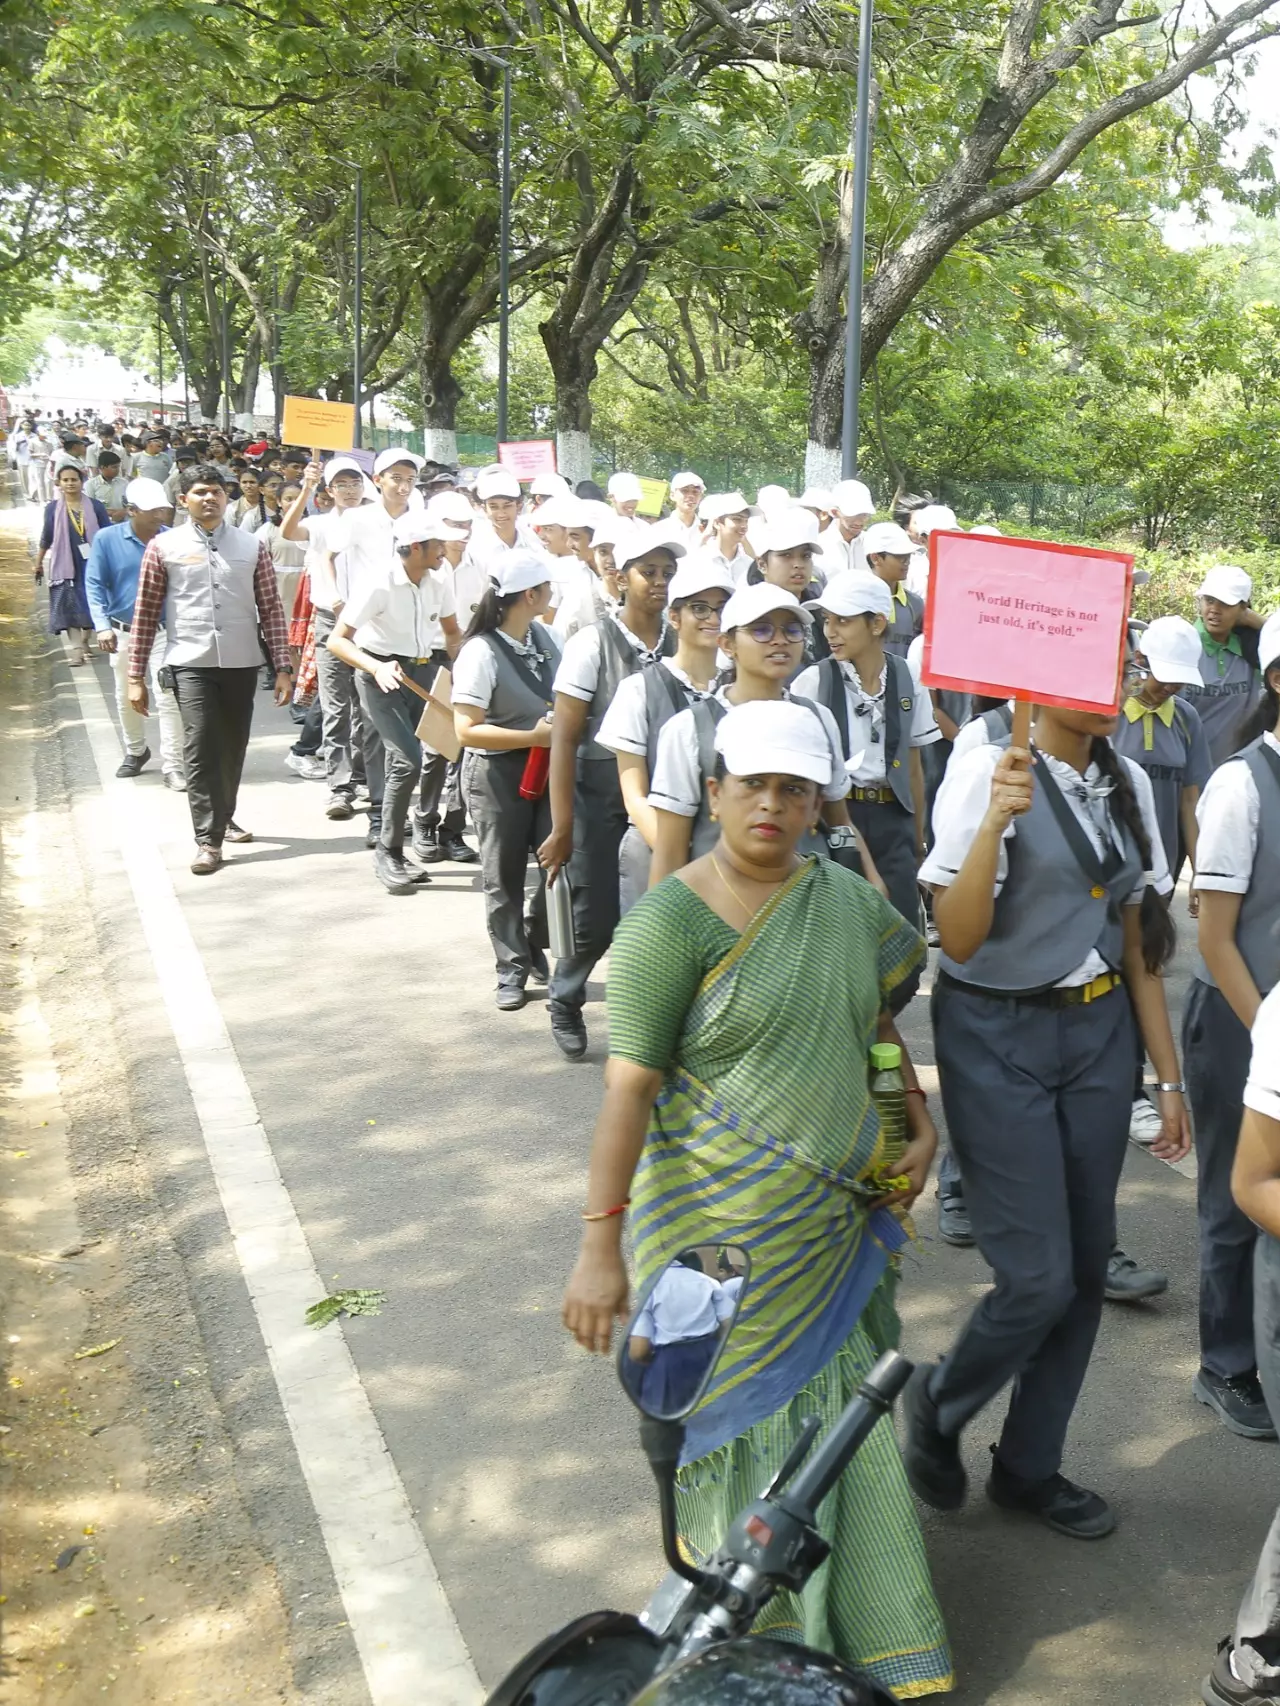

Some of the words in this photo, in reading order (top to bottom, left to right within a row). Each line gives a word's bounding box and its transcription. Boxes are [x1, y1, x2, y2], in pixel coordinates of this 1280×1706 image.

[1015, 598, 1064, 617] Heritage
[1066, 607, 1076, 619] is
[1078, 611, 1098, 622] not
[978, 611, 1000, 624] just
[1003, 616, 1024, 629] old,
[1027, 619, 1044, 632] it's
